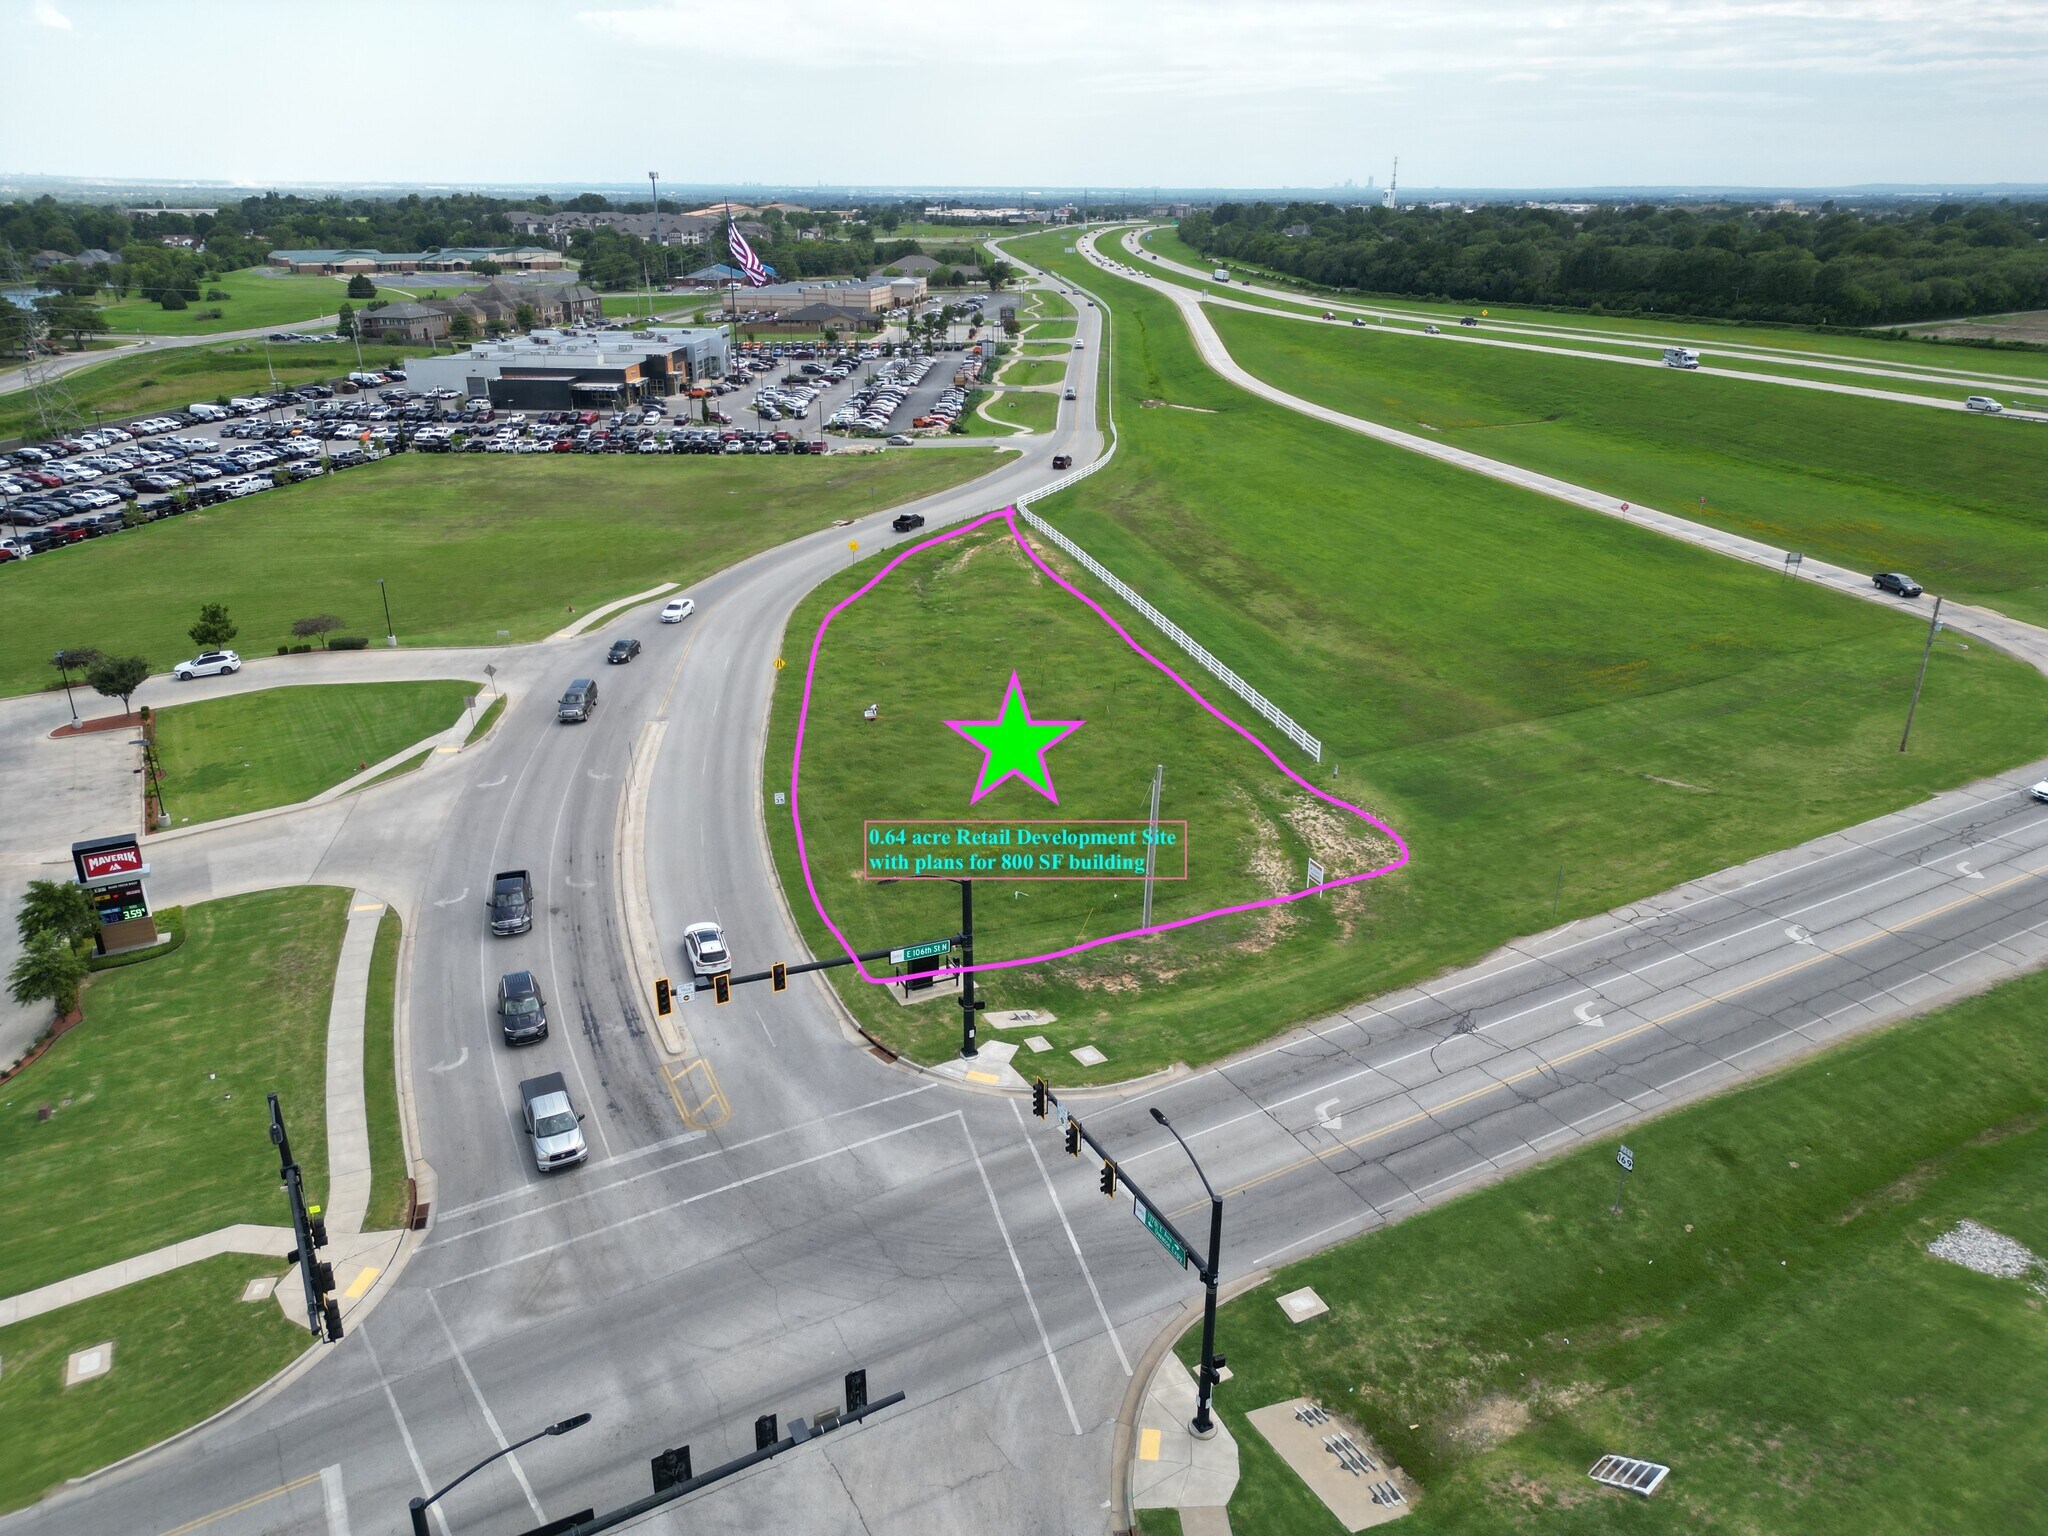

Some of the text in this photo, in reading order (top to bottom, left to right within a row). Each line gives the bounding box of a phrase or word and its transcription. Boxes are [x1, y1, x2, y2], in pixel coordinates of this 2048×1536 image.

[88, 851, 137, 871] MAVERIK
[913, 946, 932, 957] 106th
[1619, 1154, 1632, 1167] 169
